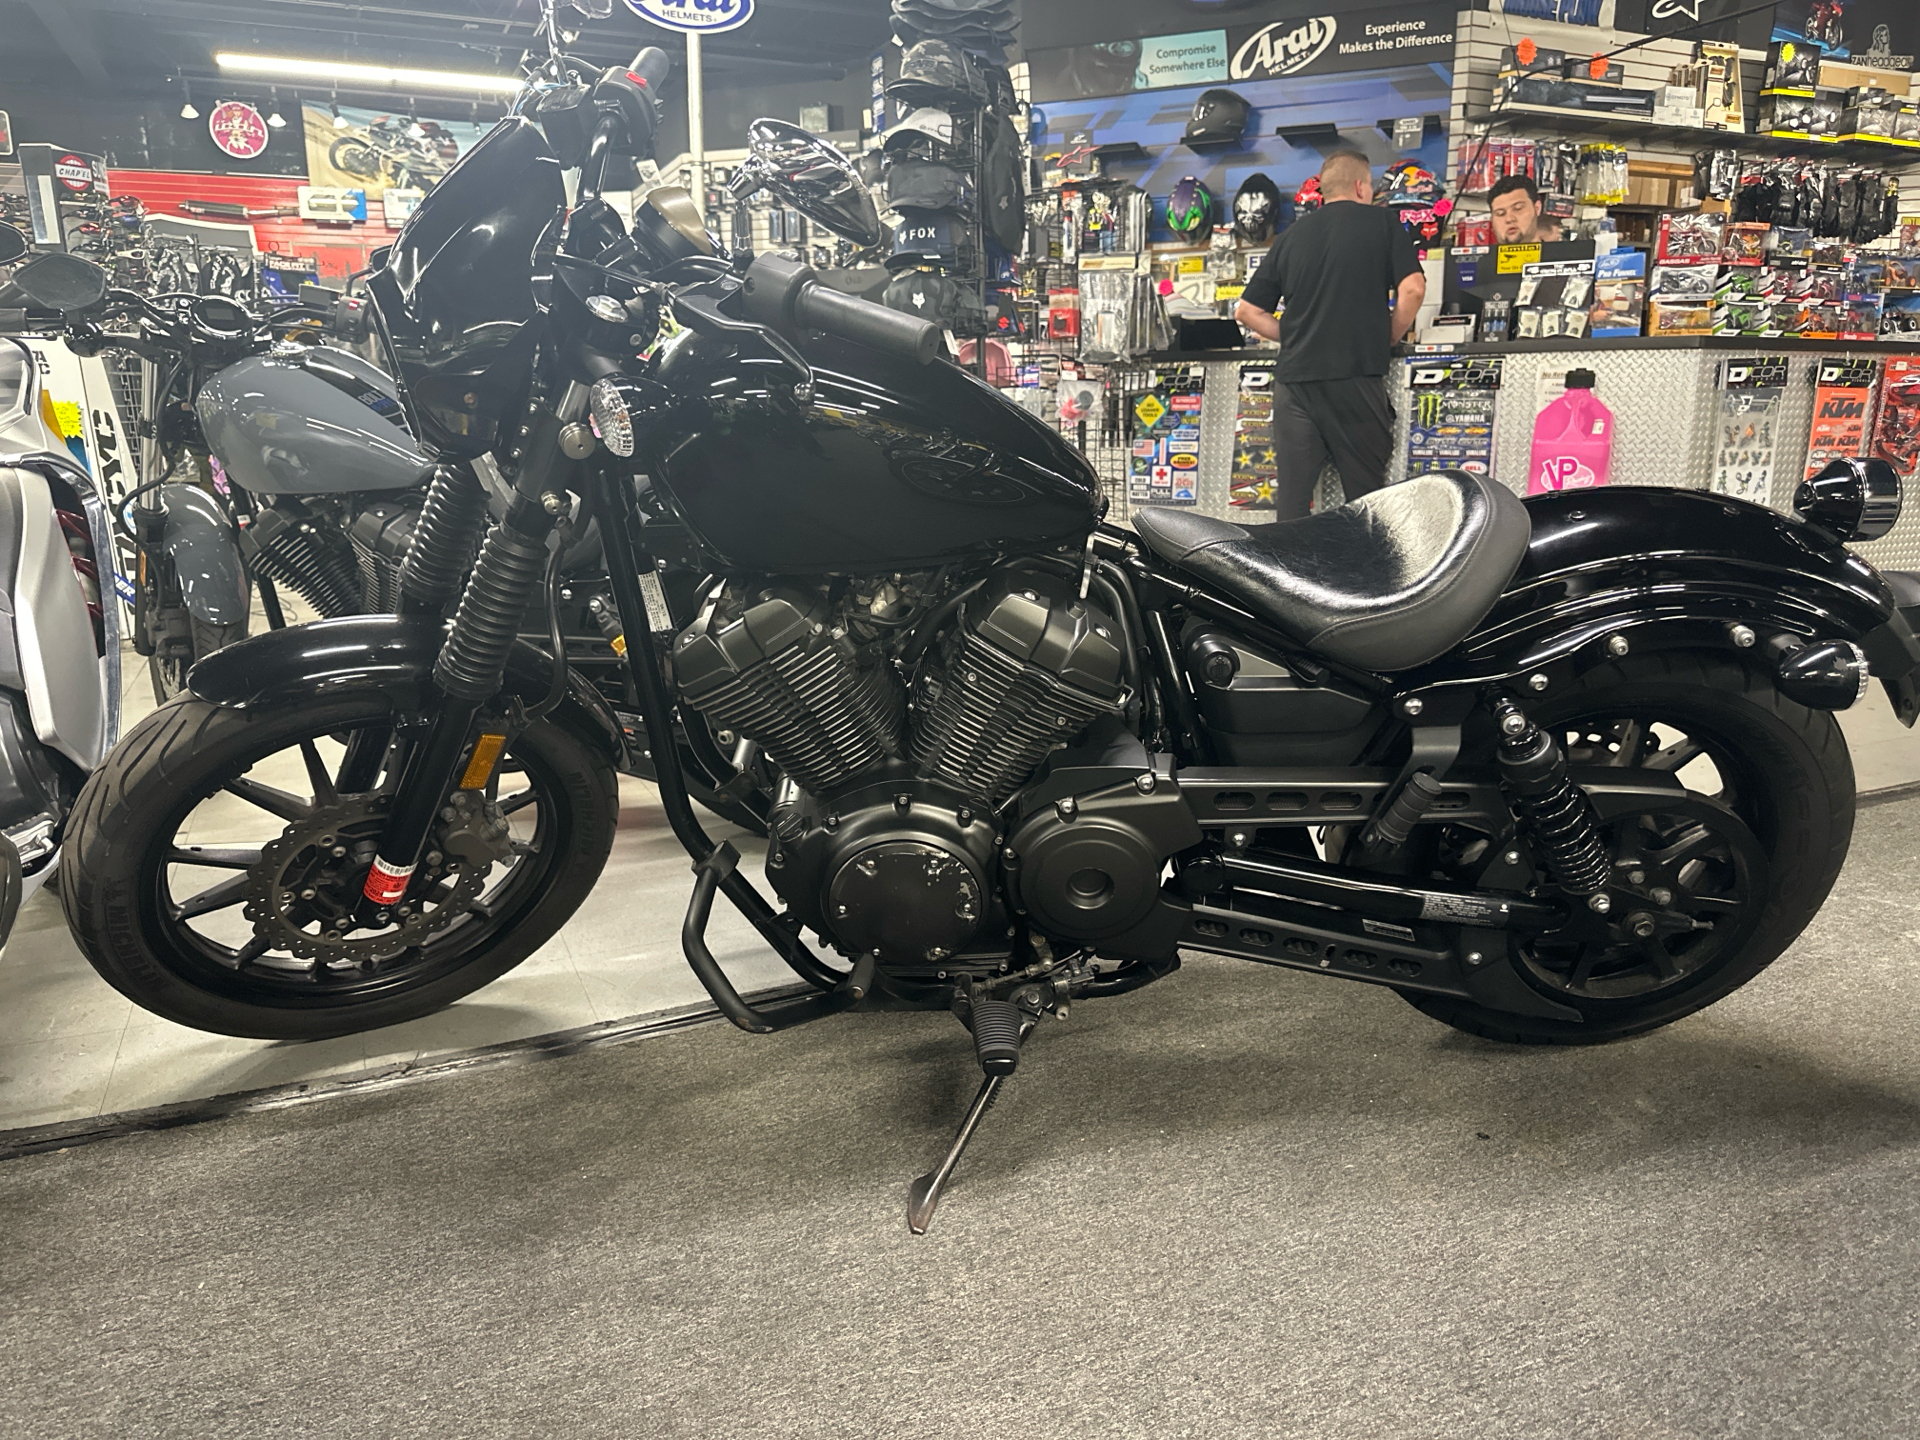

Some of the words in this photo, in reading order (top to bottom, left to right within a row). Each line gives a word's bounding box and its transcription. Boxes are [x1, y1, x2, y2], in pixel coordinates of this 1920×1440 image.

[661, 9, 713, 23] HELMETS
[1365, 19, 1426, 37] Experience
[1156, 43, 1217, 60] Compromise
[1238, 17, 1326, 72] Arai
[1339, 41, 1373, 55] Makes
[1375, 38, 1394, 51] the
[1396, 32, 1453, 49] Difference
[1149, 60, 1204, 75] Somewhere
[1206, 57, 1226, 70] Else
[1268, 51, 1311, 76] HELMET
[909, 226, 936, 241] FOX
[1818, 397, 1866, 418] KTM
[1455, 414, 1485, 422] YAMAHA
[1814, 435, 1835, 446] KTM
[1836, 435, 1860, 446] KTM
[1541, 456, 1580, 491] VP
